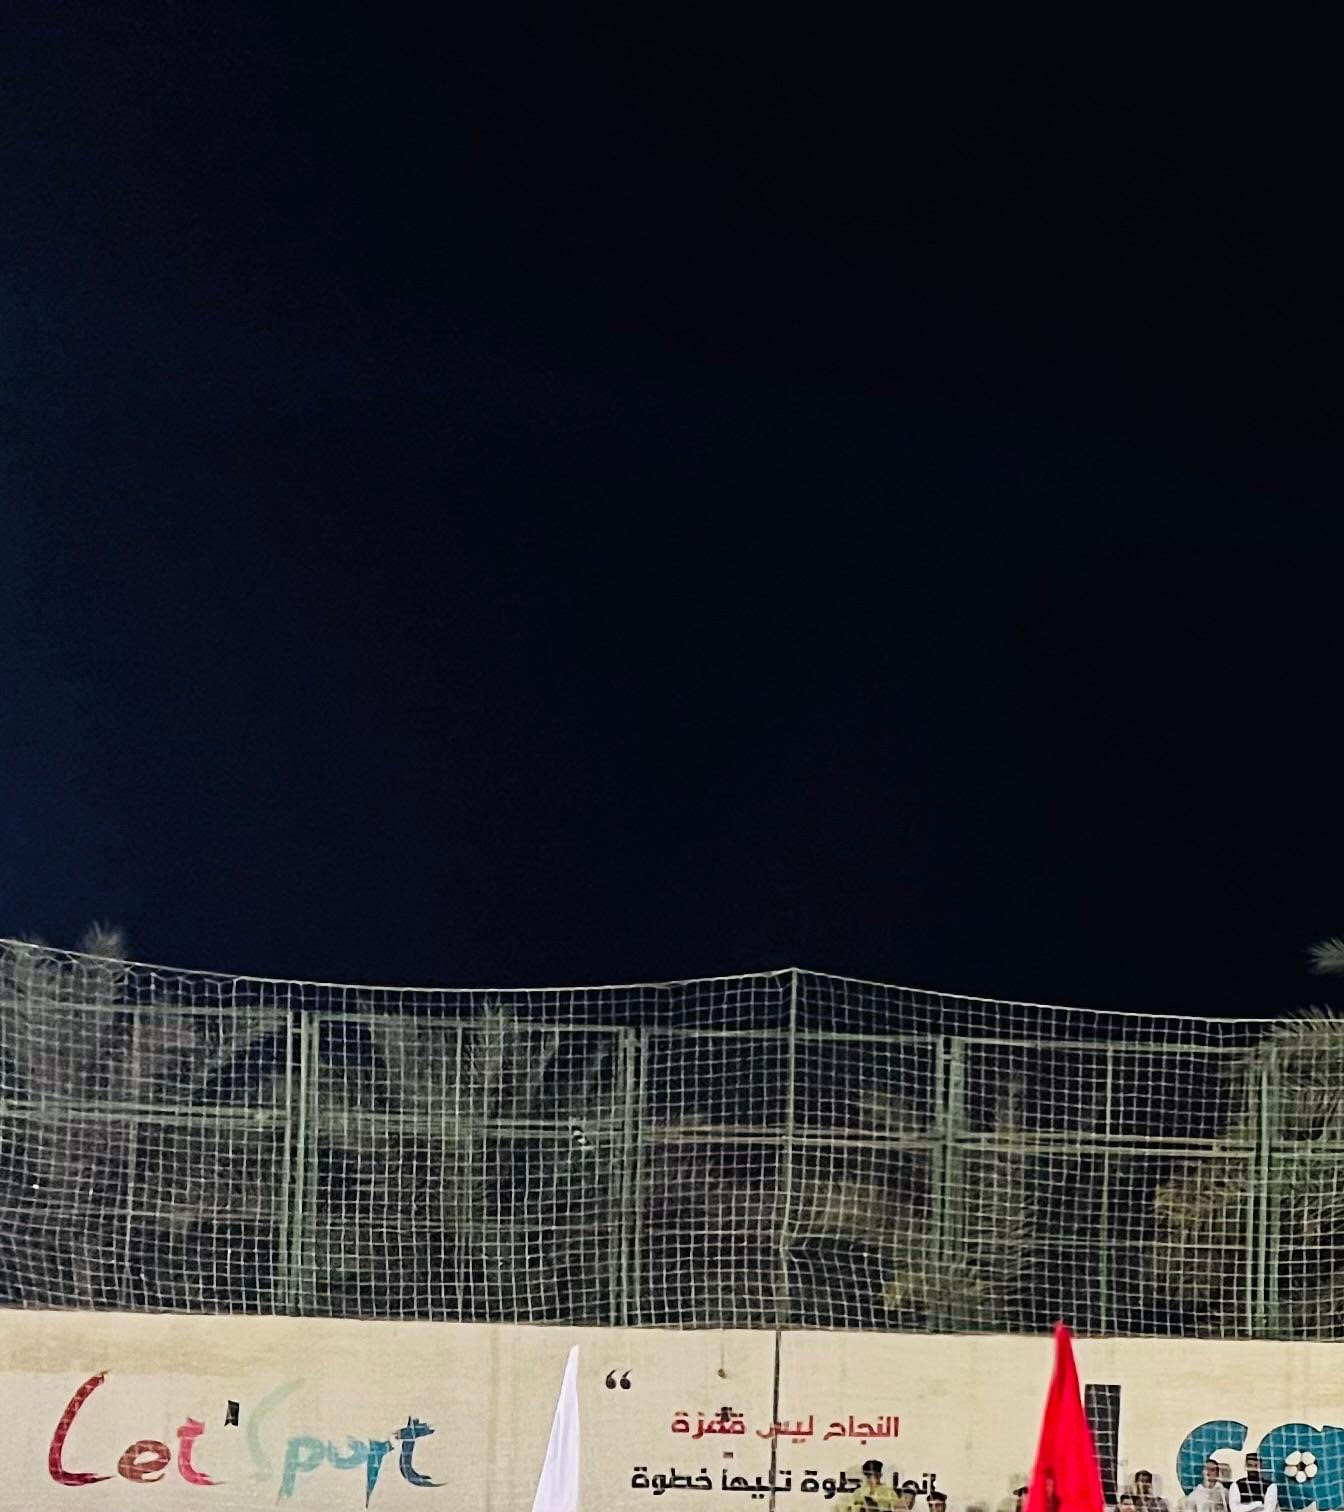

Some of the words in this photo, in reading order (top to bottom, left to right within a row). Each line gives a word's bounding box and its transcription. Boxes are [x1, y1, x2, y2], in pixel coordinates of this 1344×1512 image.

[671, 1406, 746, 1439] قفزة
[756, 1415, 814, 1443] ليس
[823, 1405, 899, 1445] النجاح
[631, 1467, 713, 1495] خطوة
[801, 1470, 862, 1500] طوة
